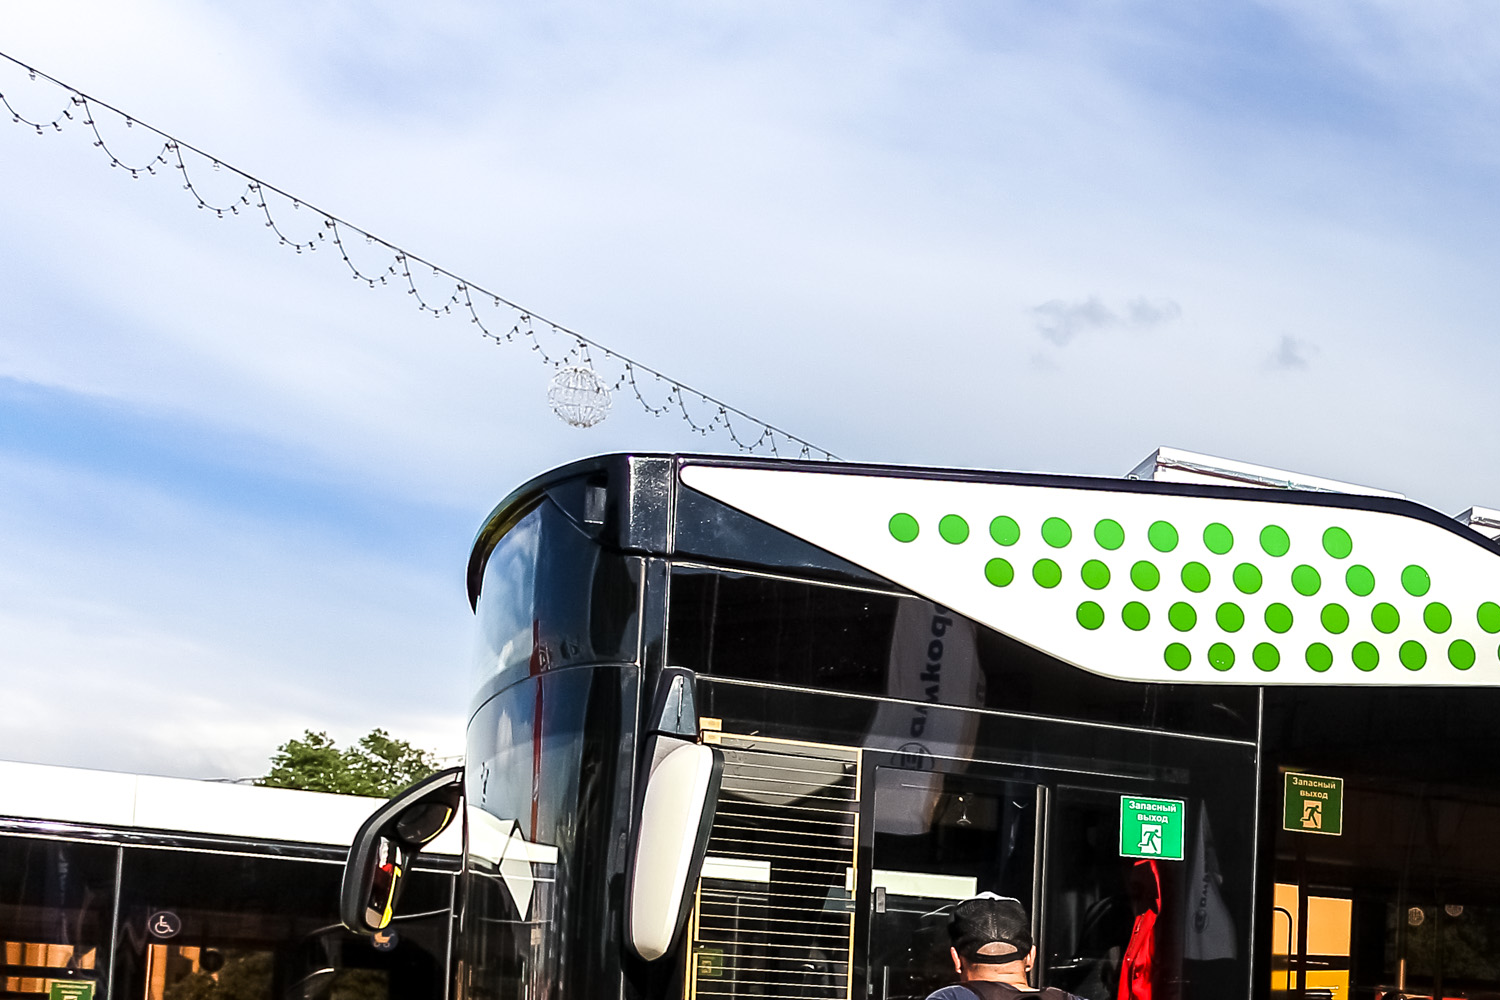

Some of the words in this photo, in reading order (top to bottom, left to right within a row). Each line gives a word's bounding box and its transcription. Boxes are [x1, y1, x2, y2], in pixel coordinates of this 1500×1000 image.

[1292, 777, 1336, 789] Запасный
[1300, 790, 1328, 800] выход
[1129, 801, 1177, 812] Запасный
[1137, 813, 1169, 824] выход
